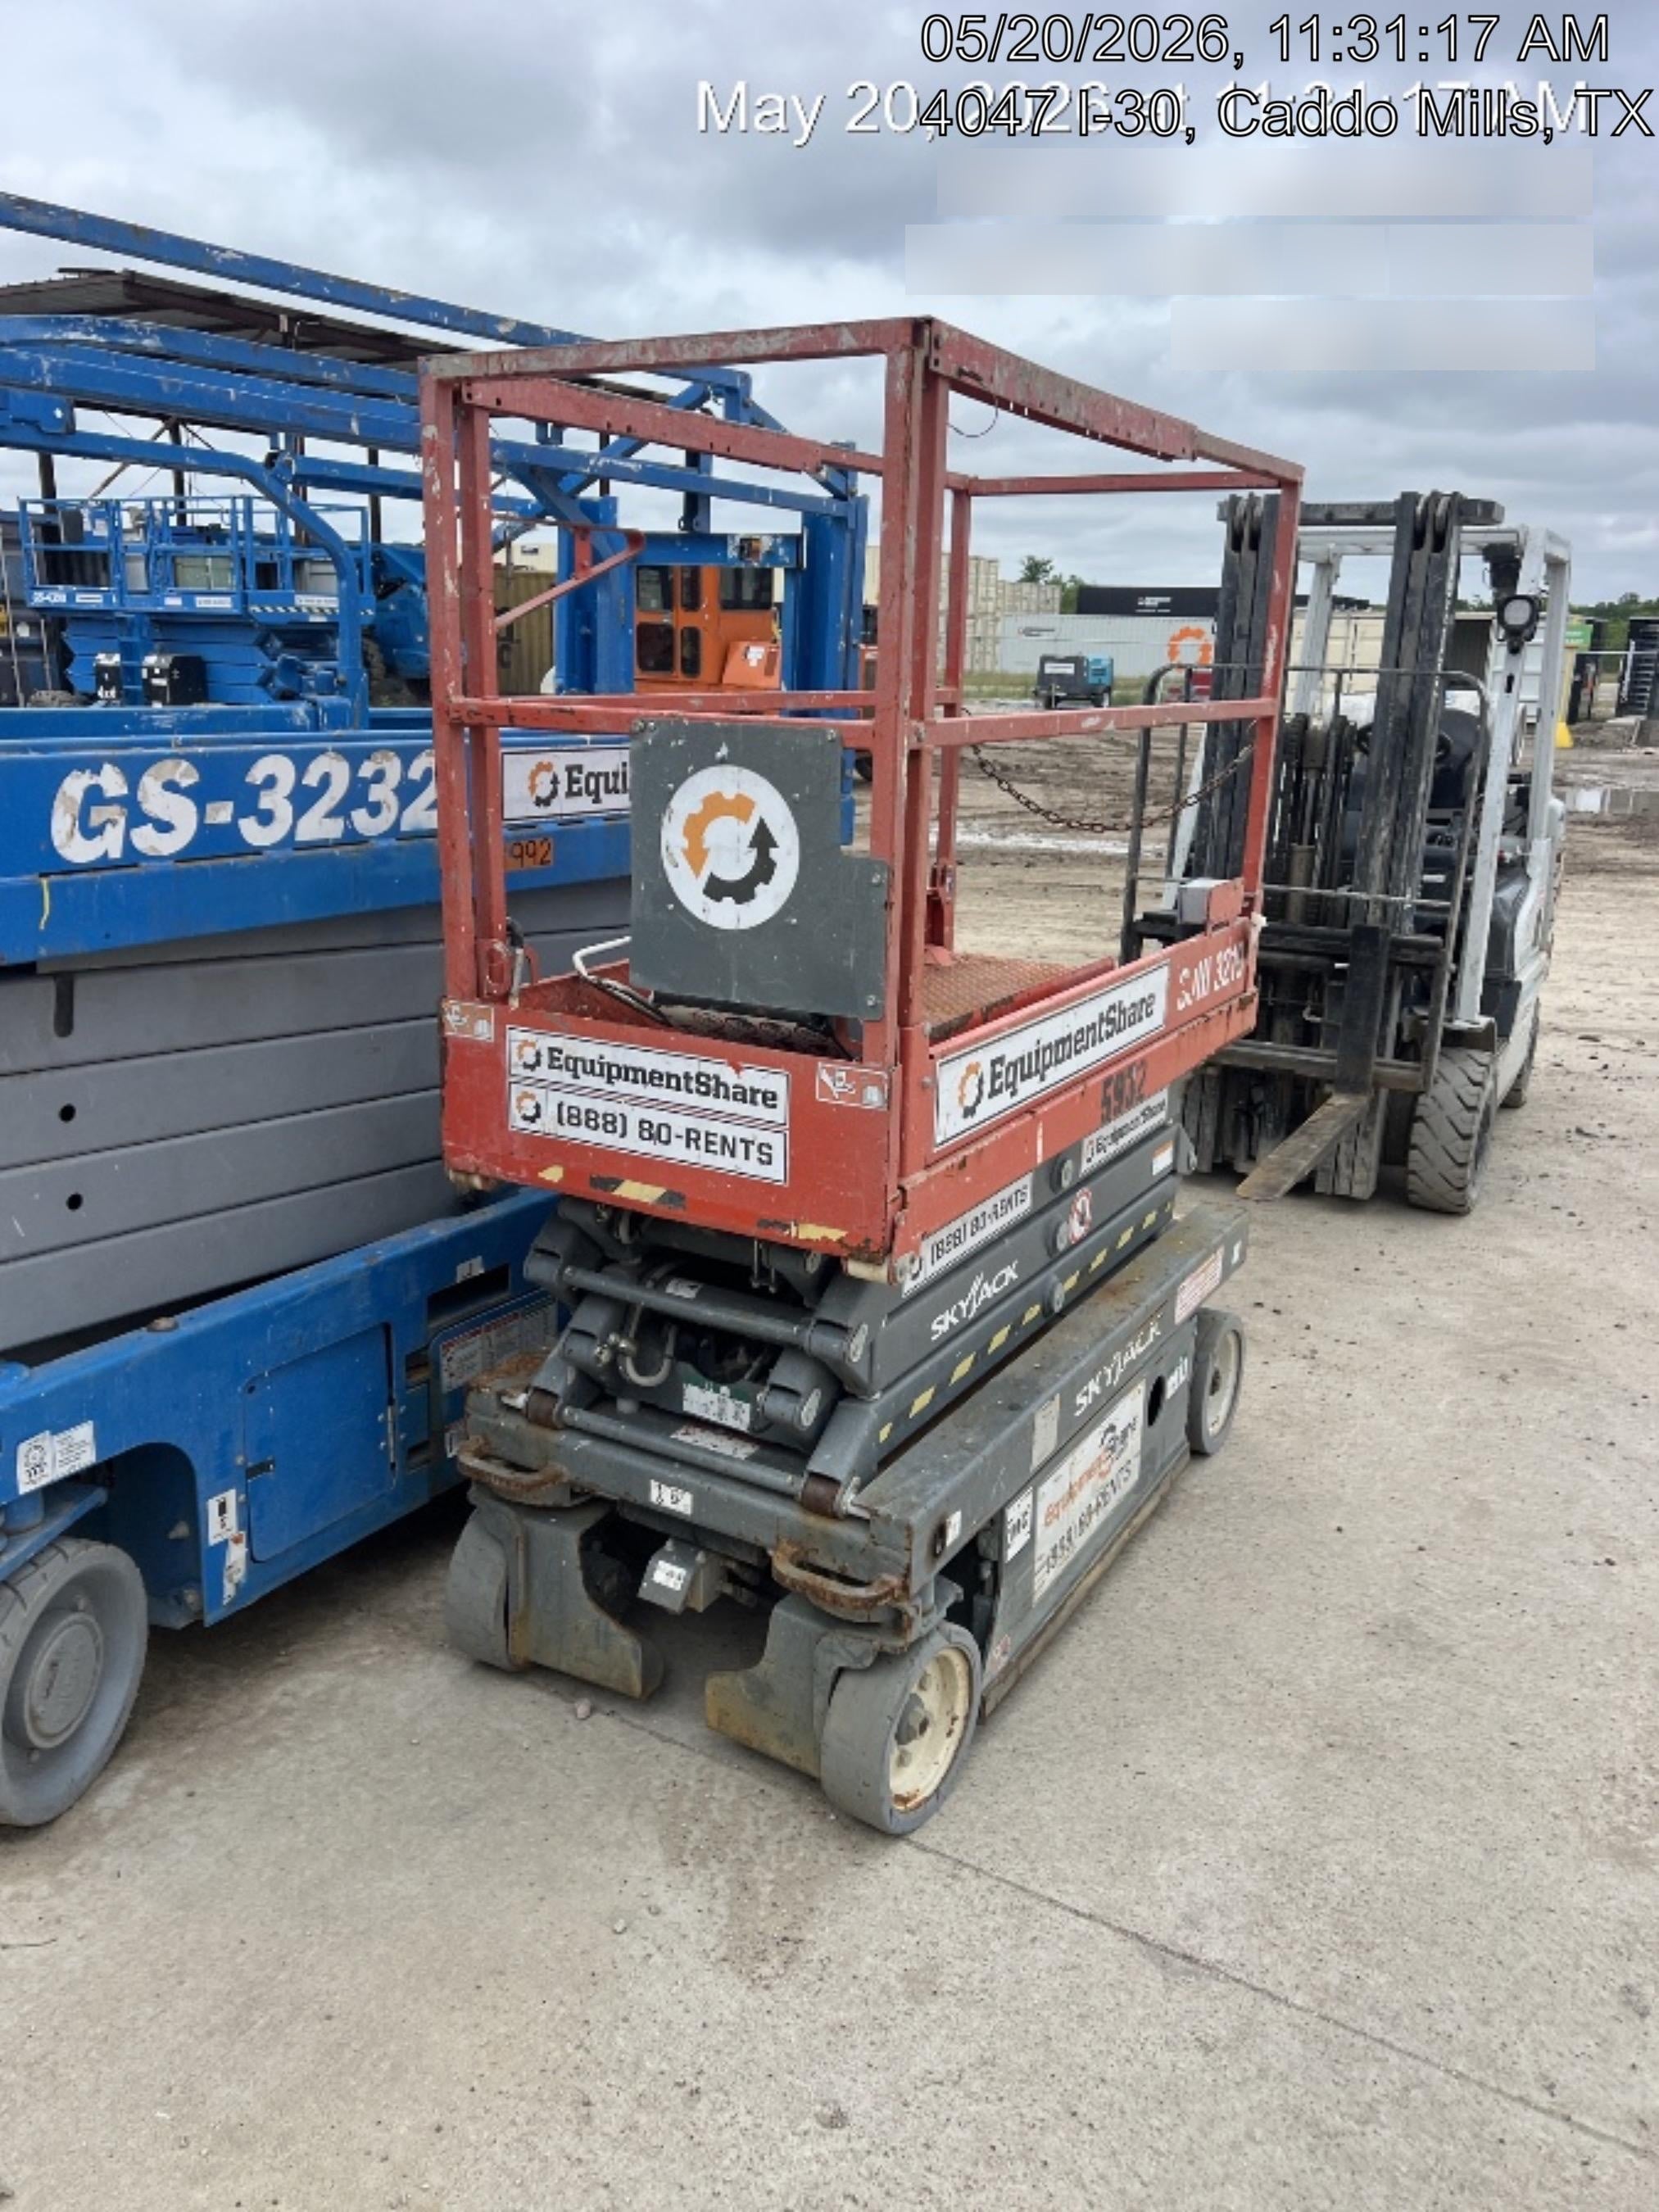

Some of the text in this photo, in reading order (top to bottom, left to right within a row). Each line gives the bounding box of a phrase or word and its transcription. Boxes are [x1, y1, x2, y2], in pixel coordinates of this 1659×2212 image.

[50, 749, 437, 863] GS-3232
[546, 1045, 778, 1109] EquipmentShare
[987, 991, 1156, 1101] EquipmentShare
[556, 1104, 773, 1167] (888) 80-RENTS
[931, 1258, 1018, 1340] SKYJACK
[1074, 1312, 1162, 1417] SKYJACK
